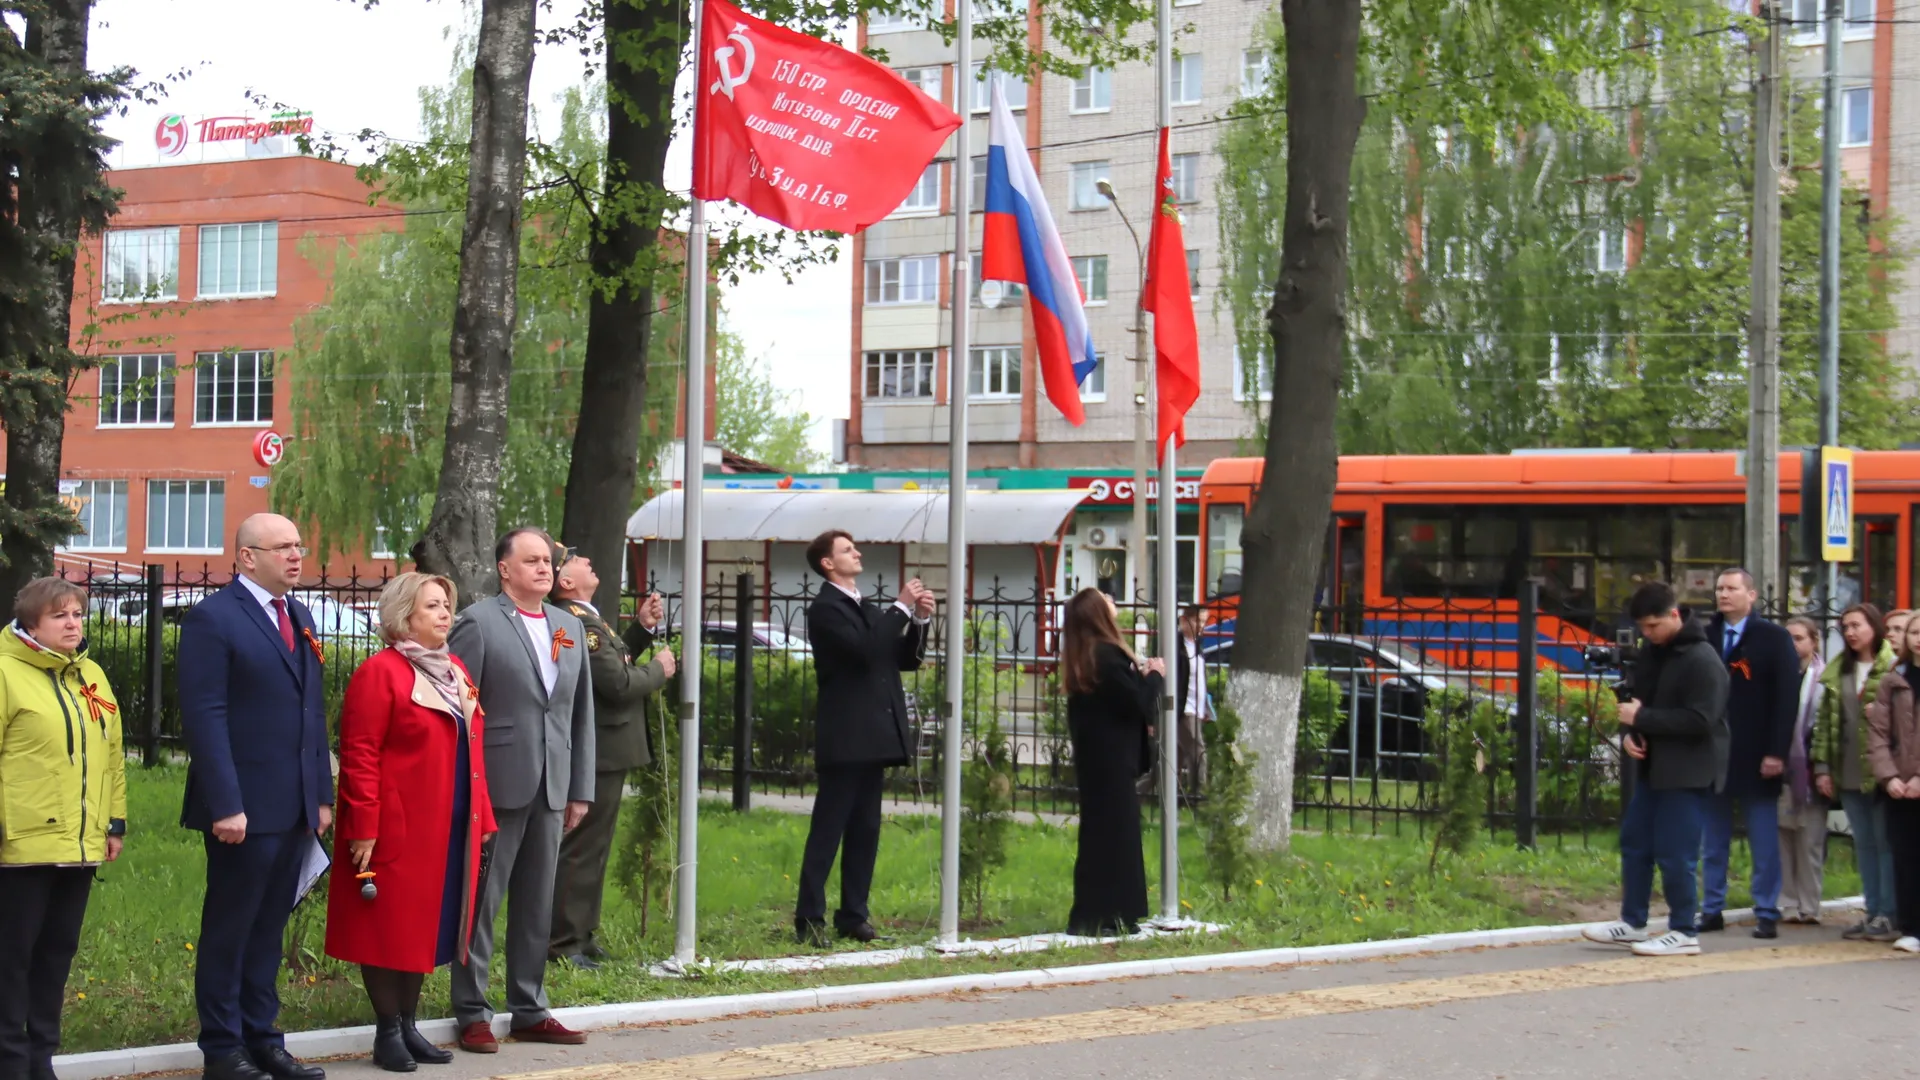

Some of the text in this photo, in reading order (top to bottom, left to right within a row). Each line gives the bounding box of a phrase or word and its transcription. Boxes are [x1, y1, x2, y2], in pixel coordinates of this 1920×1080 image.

[771, 59, 900, 120] 150 СТР. ОРДЕНА
